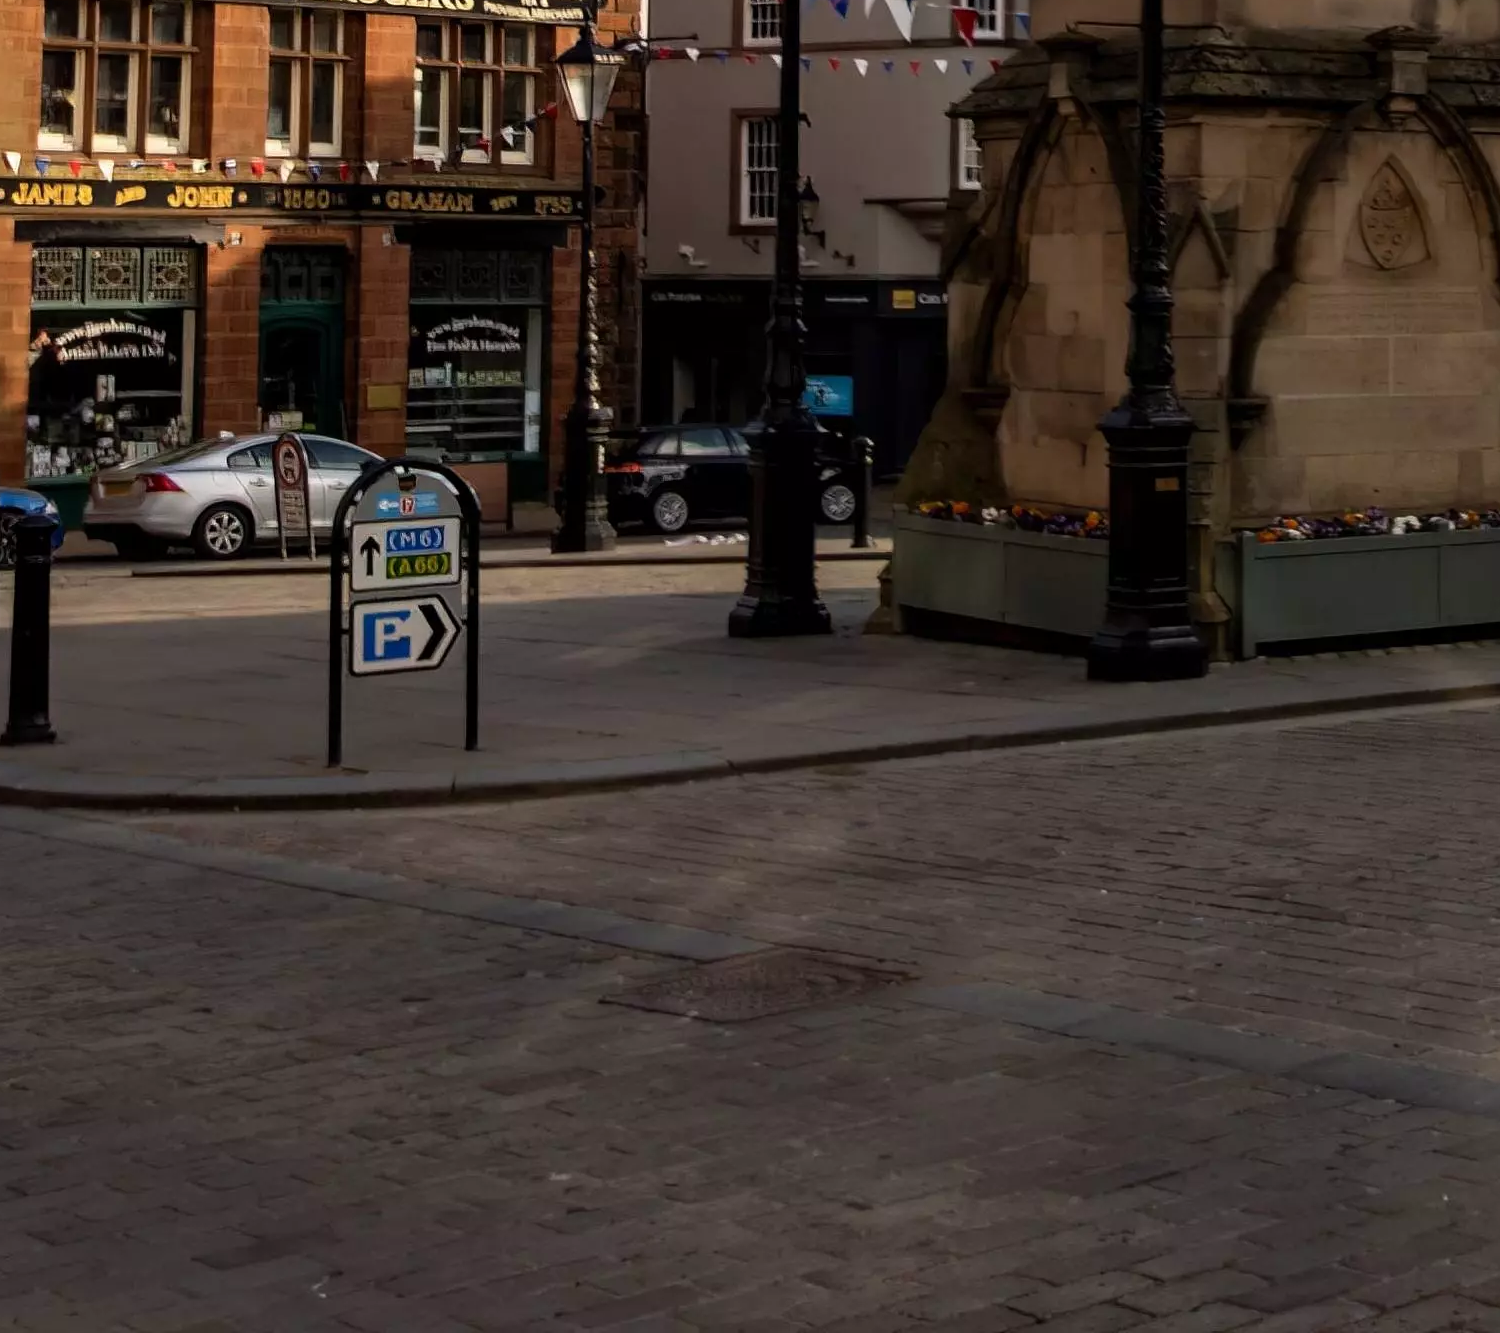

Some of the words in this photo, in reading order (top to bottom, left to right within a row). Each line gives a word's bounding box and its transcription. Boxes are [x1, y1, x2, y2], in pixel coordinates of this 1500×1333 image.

[12, 183, 93, 206] JAMES
[167, 185, 235, 208] JOHN
[385, 189, 474, 212] GRAHAM
[389, 527, 444, 551] (M6)
[388, 553, 449, 578] (A66)
[374, 616, 406, 658] P
